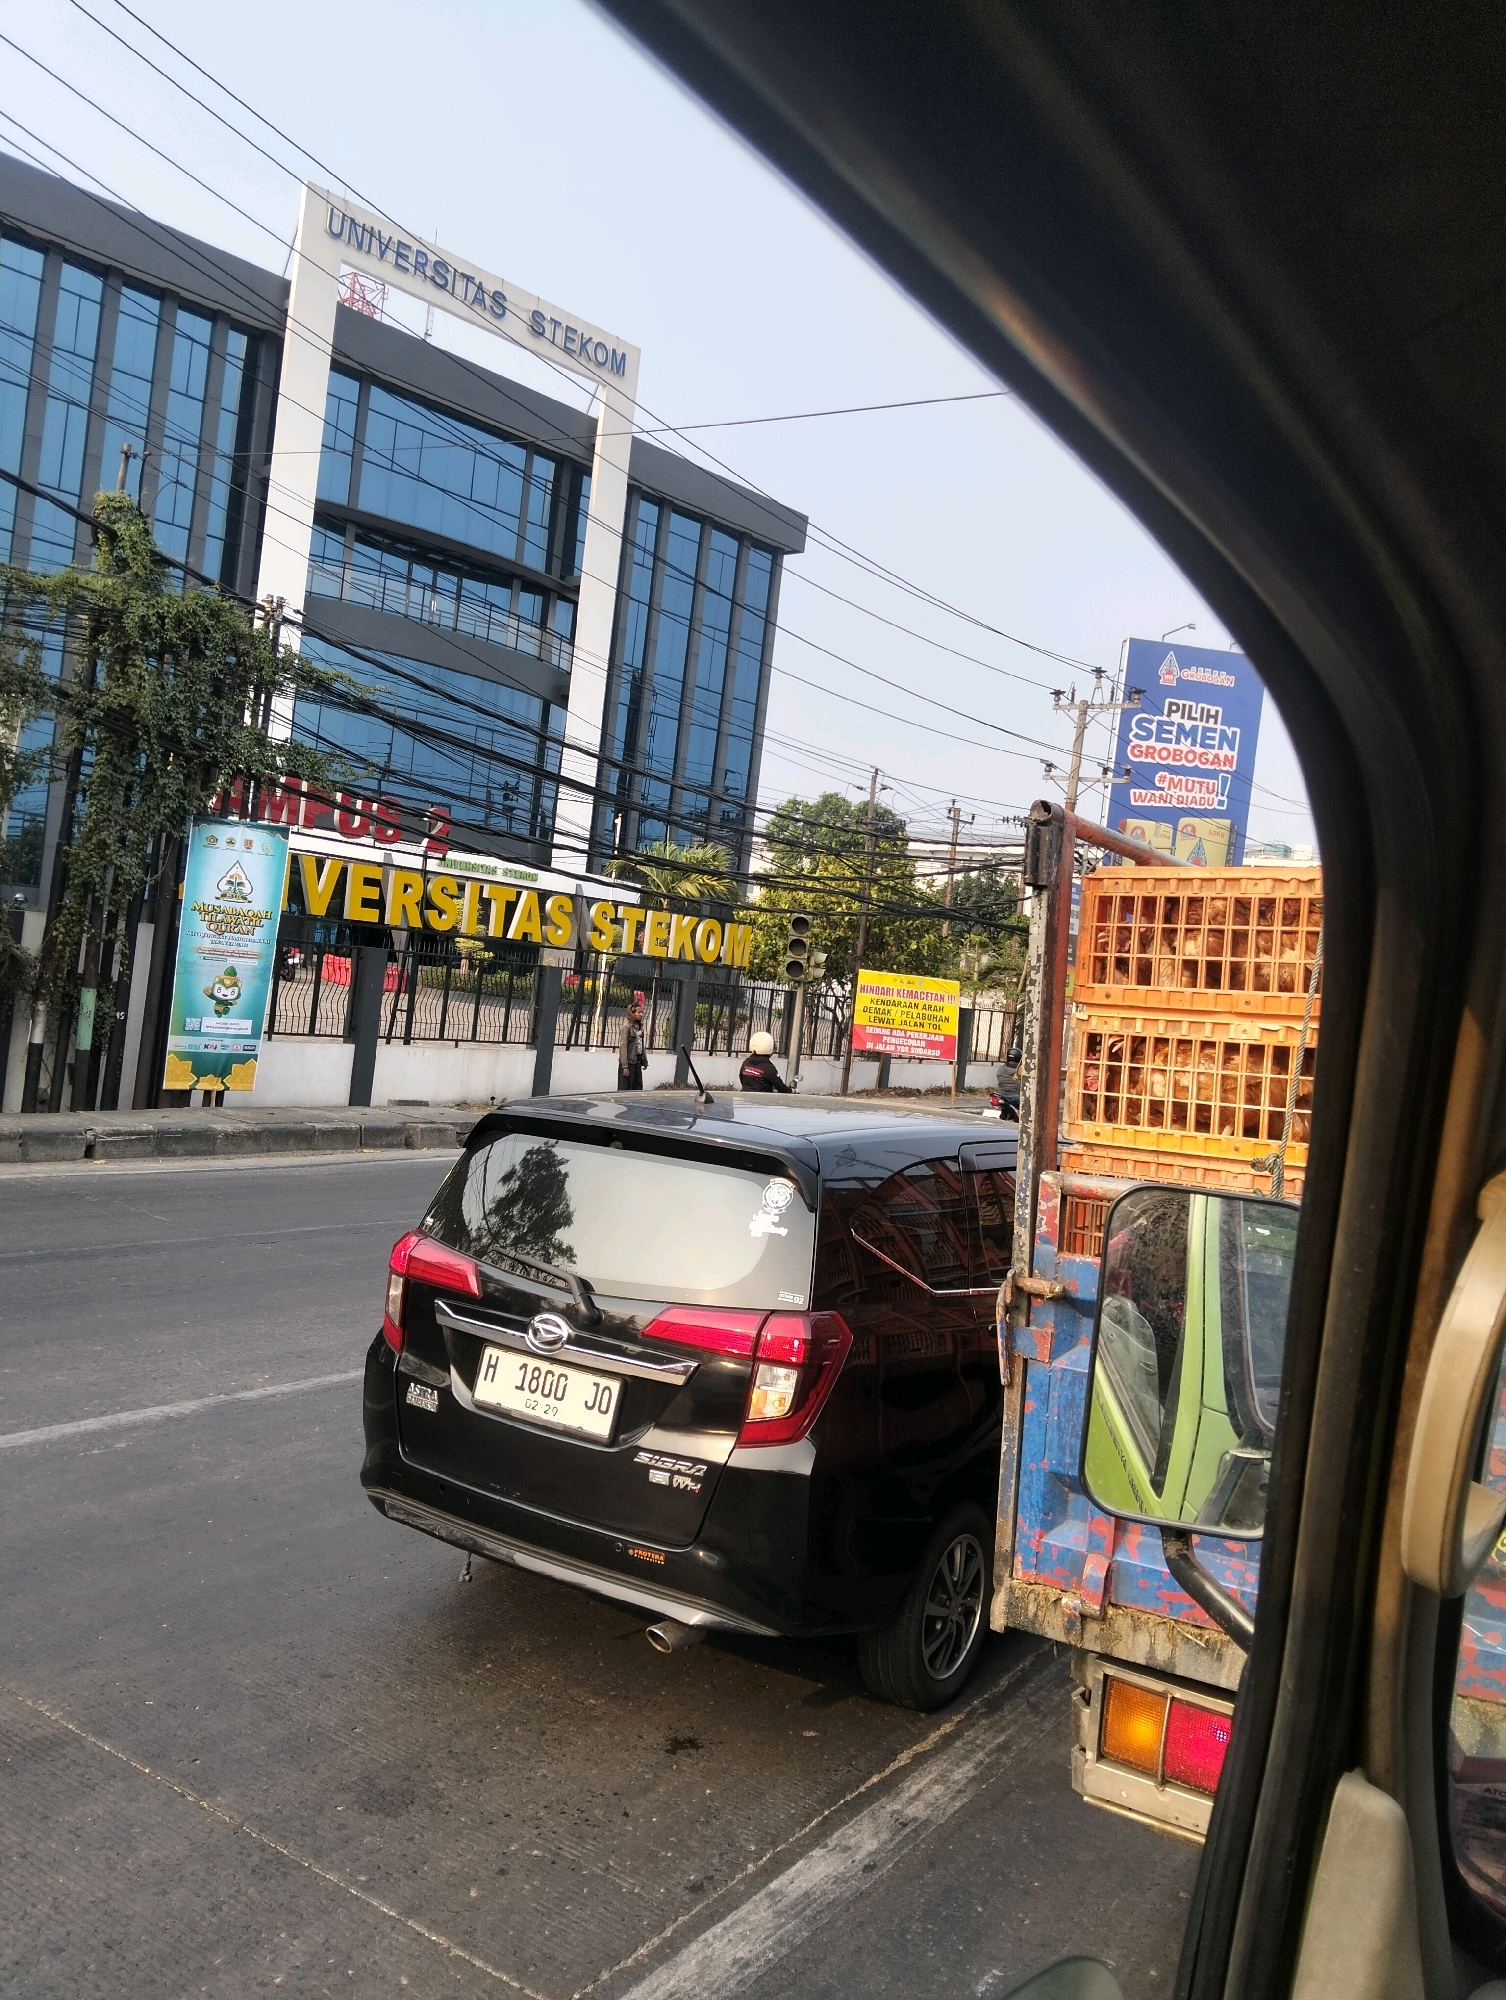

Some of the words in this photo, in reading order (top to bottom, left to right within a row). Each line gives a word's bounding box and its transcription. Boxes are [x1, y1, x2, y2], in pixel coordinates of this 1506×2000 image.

[325, 206, 508, 319] UNIVERSITAS
[527, 308, 627, 377] STEKOM
[1181, 669, 1234, 687] GROBOGAN
[1166, 700, 1220, 725] PILIH
[1130, 716, 1238, 752] SEMEN
[1129, 743, 1235, 770] GROBOGAN
[1132, 791, 1173, 805] WANI
[1176, 793, 1215, 807] DIADU
[212, 775, 403, 844] AMPUS
[1208, 829, 1225, 839] 50Kg
[191, 901, 273, 919] MUSABAQAH
[199, 911, 264, 928] TILAWATIL
[206, 921, 256, 937] QURAN
[586, 901, 753, 968] STEKOM
[860, 983, 894, 997] HINDARI
[896, 988, 945, 1003] KEMACETAN
[947, 994, 956, 1004] !!!
[870, 997, 919, 1010] KENDARAAN
[922, 1003, 944, 1013] ARAH
[862, 1006, 892, 1016] DEMAK
[900, 1010, 949, 1023] PELABUHAN
[868, 1015, 896, 1026] LEWAT
[898, 1019, 924, 1029] JALAN
[927, 1022, 942, 1031] TOL
[865, 1026, 891, 1036] SEDANG
[892, 1028, 905, 1037] ADA
[906, 1031, 944, 1042] PEKERJAAN
[882, 1036, 926, 1047] PENGECORAN
[874, 1043, 894, 1052] JALAN
[910, 1046, 941, 1057] SUDARSO
[793, 1296, 805, 1305] 92
[407, 1382, 438, 1403] ASTRA
[483, 1353, 499, 1383] H
[514, 1362, 569, 1402] 1800
[584, 1381, 613, 1415] JO
[633, 1451, 708, 1477] SIGRA
